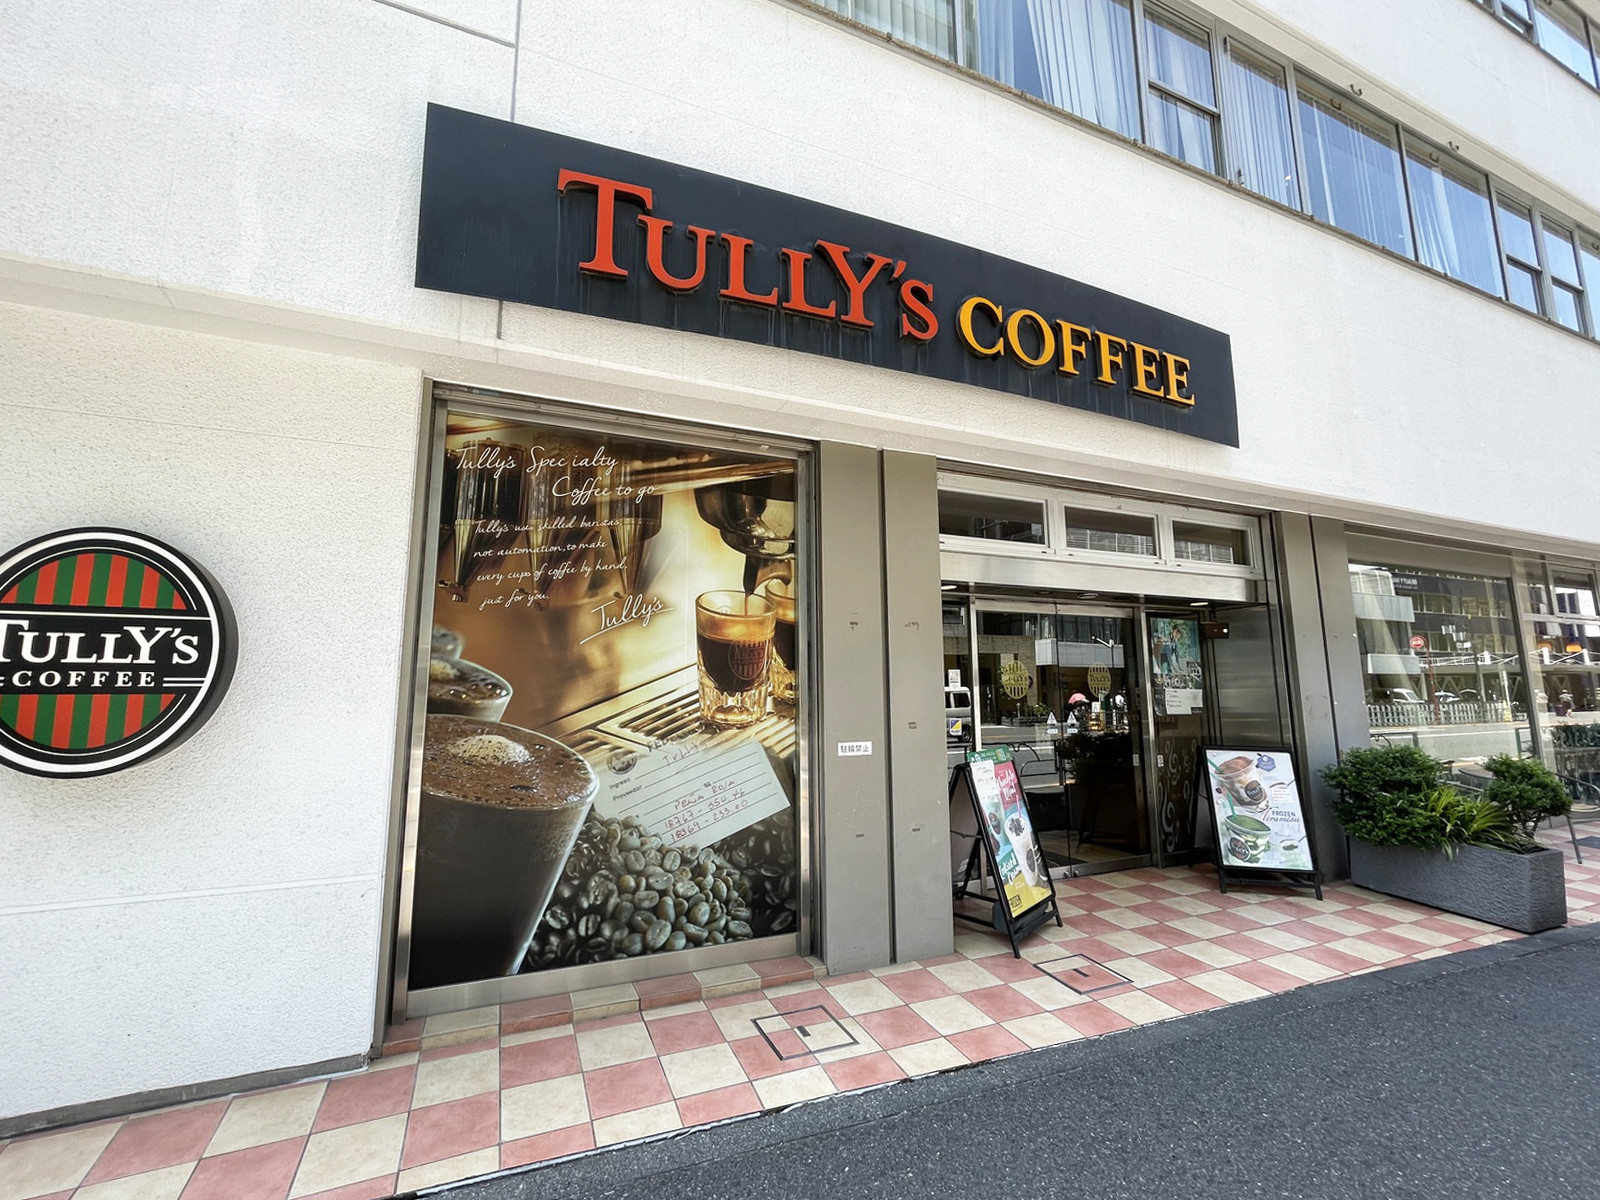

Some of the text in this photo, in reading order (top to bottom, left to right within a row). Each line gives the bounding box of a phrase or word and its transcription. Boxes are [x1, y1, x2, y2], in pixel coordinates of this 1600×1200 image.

[557, 168, 1196, 407] TULLY'S COFFEE
[455, 445, 517, 479] Tully's
[551, 476, 660, 506] Coffee to go
[474, 519, 510, 538] Tully's
[538, 515, 575, 534] skilled
[473, 550, 494, 559] not
[578, 536, 608, 549] make
[476, 571, 503, 586] every
[533, 563, 546, 581] of
[547, 562, 577, 581] coffee
[580, 560, 593, 577] by
[478, 595, 504, 611] just
[506, 588, 525, 608] for
[591, 593, 665, 632] Tully's
[11, 670, 156, 688] COFFEE
[840, 744, 869, 754] 駐輪禁止
[612, 785, 642, 802] Proveedor
